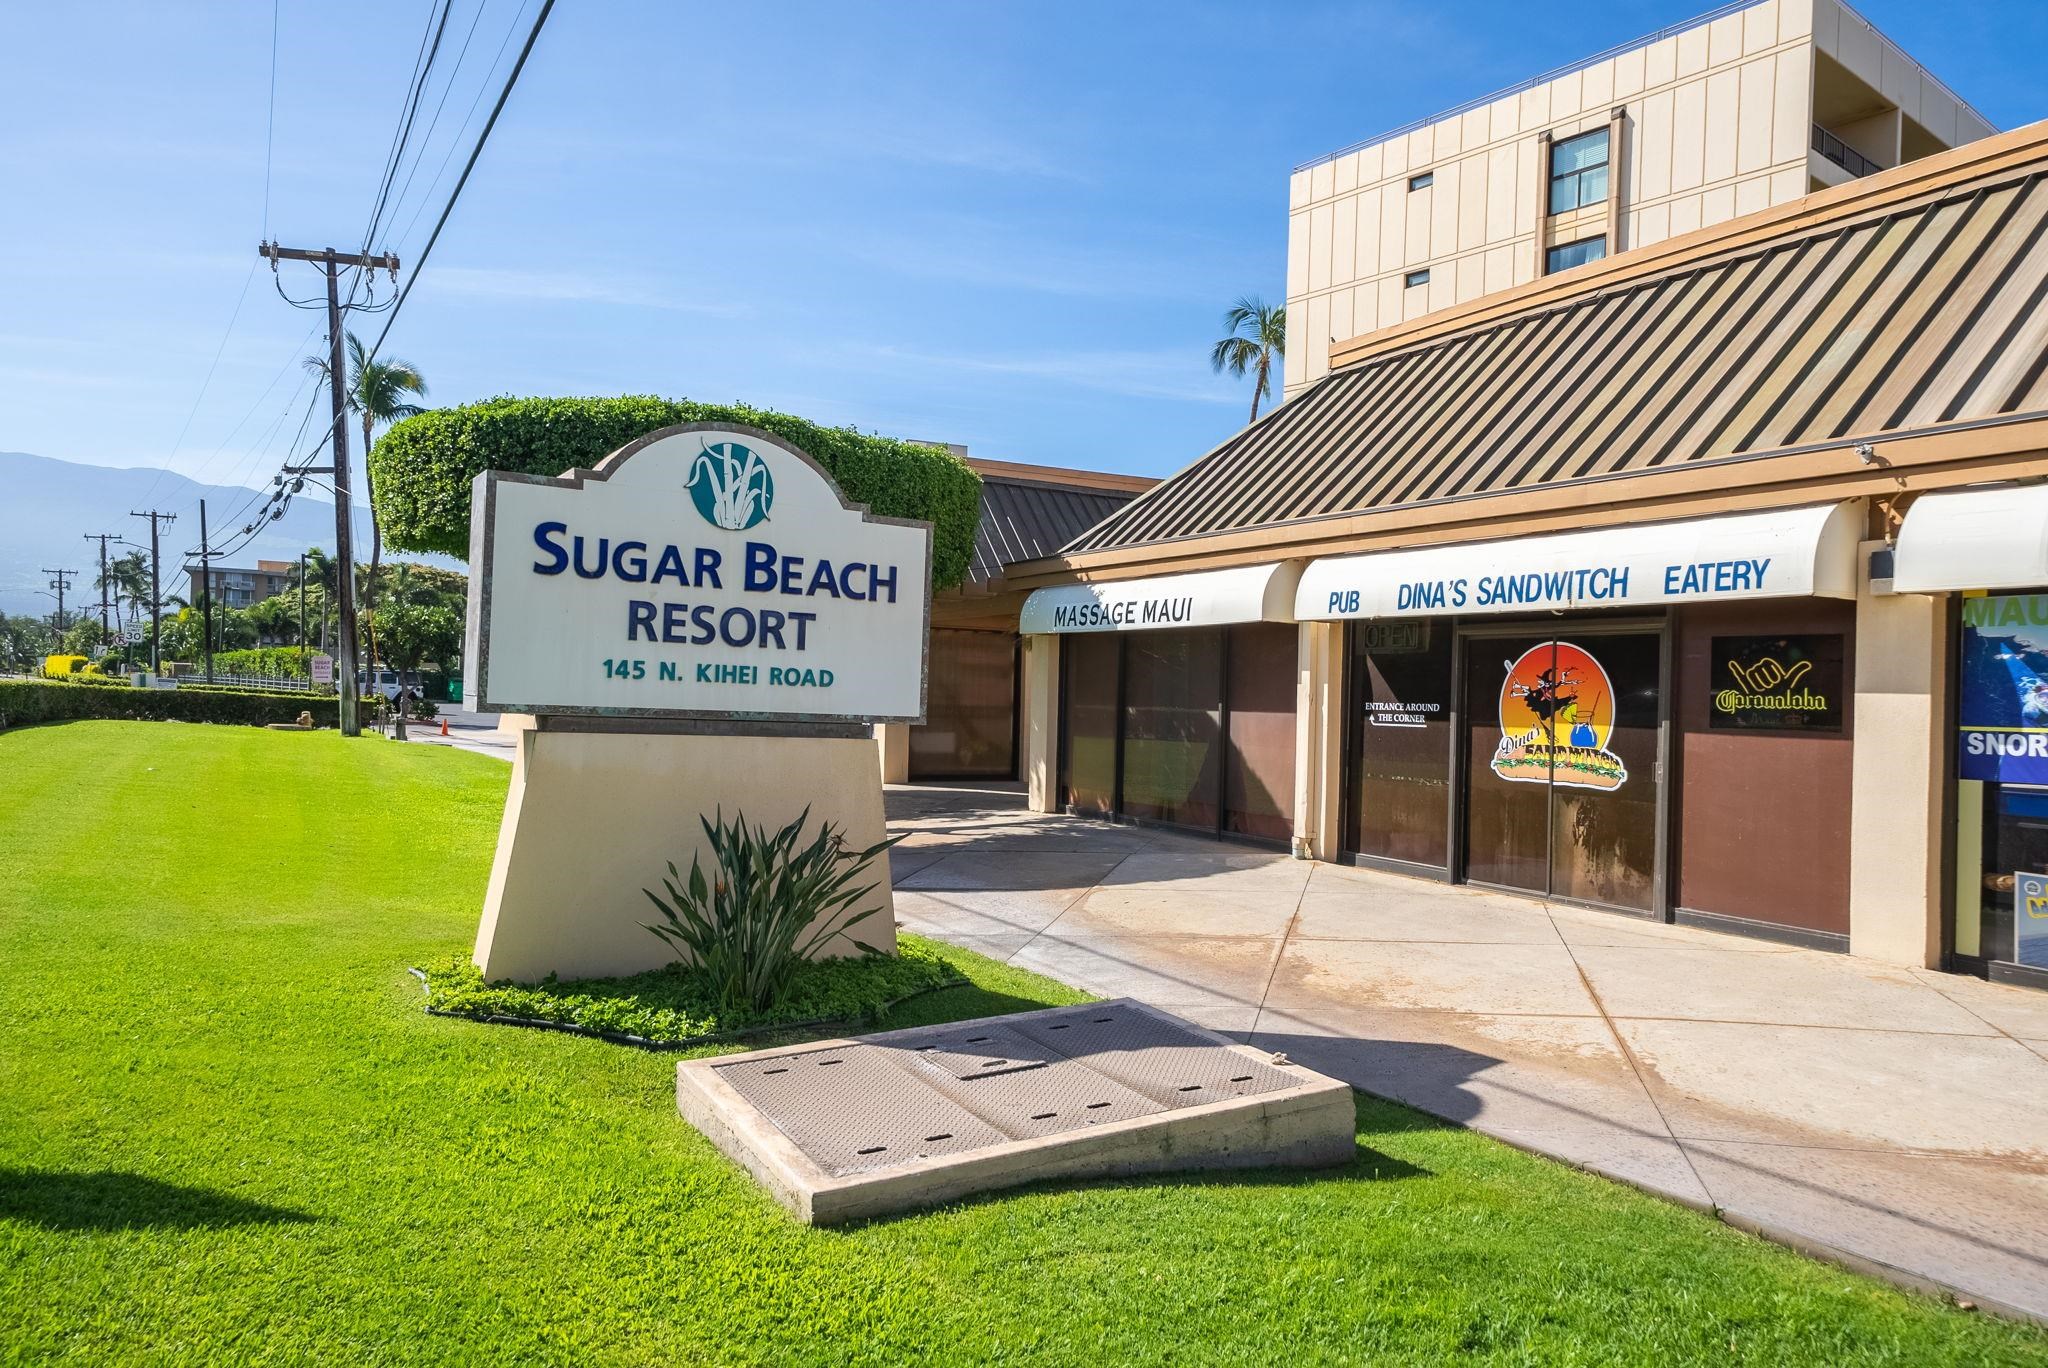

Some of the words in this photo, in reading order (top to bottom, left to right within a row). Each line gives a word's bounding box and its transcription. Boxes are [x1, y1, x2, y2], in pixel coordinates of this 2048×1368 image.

[533, 521, 722, 590] SUGAR
[744, 541, 898, 603] BEACH
[1328, 590, 1360, 613] PUB
[1397, 578, 1468, 610] DINA'S
[1476, 566, 1630, 606] SANDWITCH
[1664, 558, 1772, 595] EATERY
[628, 600, 817, 650] RESORT
[1053, 601, 1138, 627] MASSAGE
[1142, 597, 1193, 623] MAUI
[126, 632, 141, 640] 30
[1366, 625, 1416, 648] OPEN
[602, 659, 646, 680] 145
[659, 662, 684, 682] N.
[696, 664, 758, 685] KIHEI
[770, 667, 834, 688] ROAD
[1365, 702, 1404, 711] ENTRANCE
[1405, 703, 1440, 712] AROUND
[1716, 688, 1827, 714] Coronaloha
[1378, 713, 1392, 722] THE
[1393, 714, 1425, 723] CORNER
